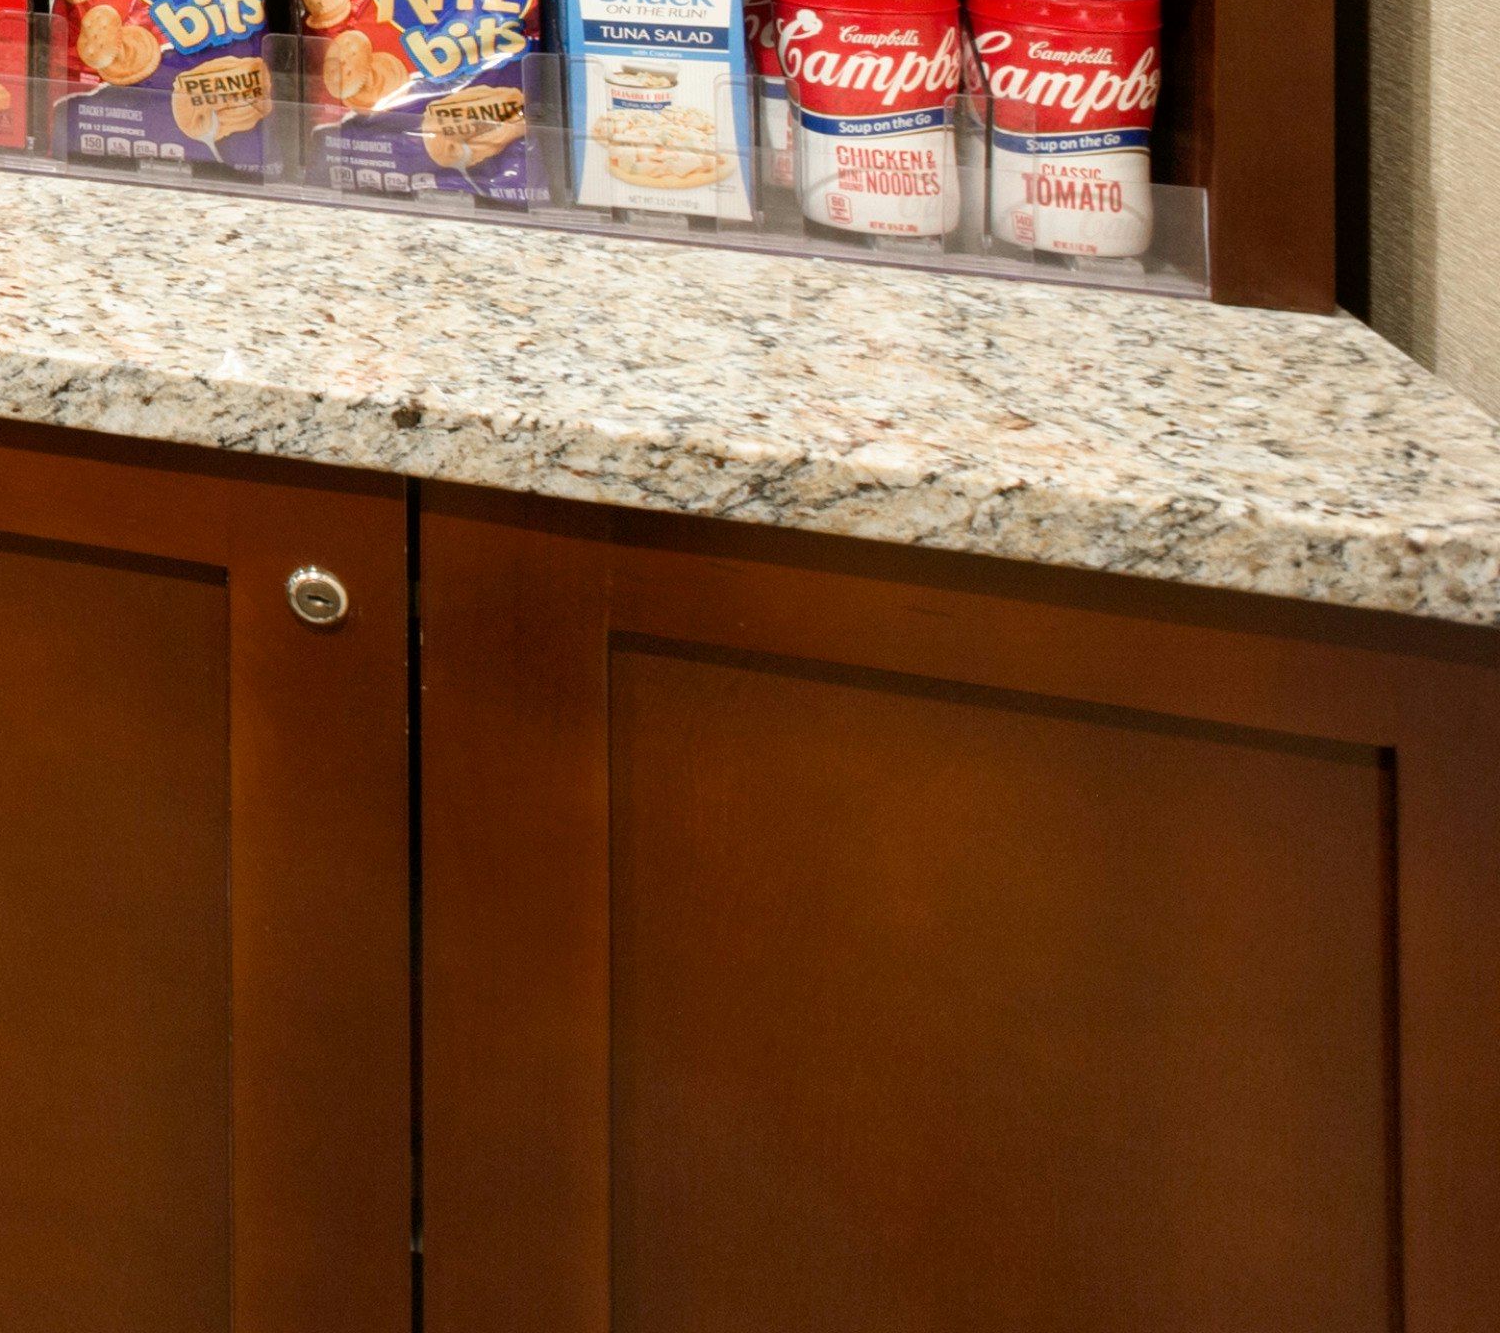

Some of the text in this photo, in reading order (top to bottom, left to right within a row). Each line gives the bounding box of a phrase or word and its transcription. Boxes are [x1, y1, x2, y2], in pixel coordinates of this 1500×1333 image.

[606, 5, 707, 19] ON THE RUN!
[600, 25, 713, 44] TUNA SALAD
[405, 18, 526, 78] bits
[185, 70, 262, 93] PEANUT
[191, 87, 263, 107] BUTTER
[839, 114, 932, 133] Soup on the Go
[1026, 134, 1121, 152] Soup on the Go
[836, 146, 920, 170] CHICKEN
[1041, 164, 1103, 180] CLASSIC
[866, 171, 941, 197] NOODLES
[1022, 173, 1122, 214] TOMATO
